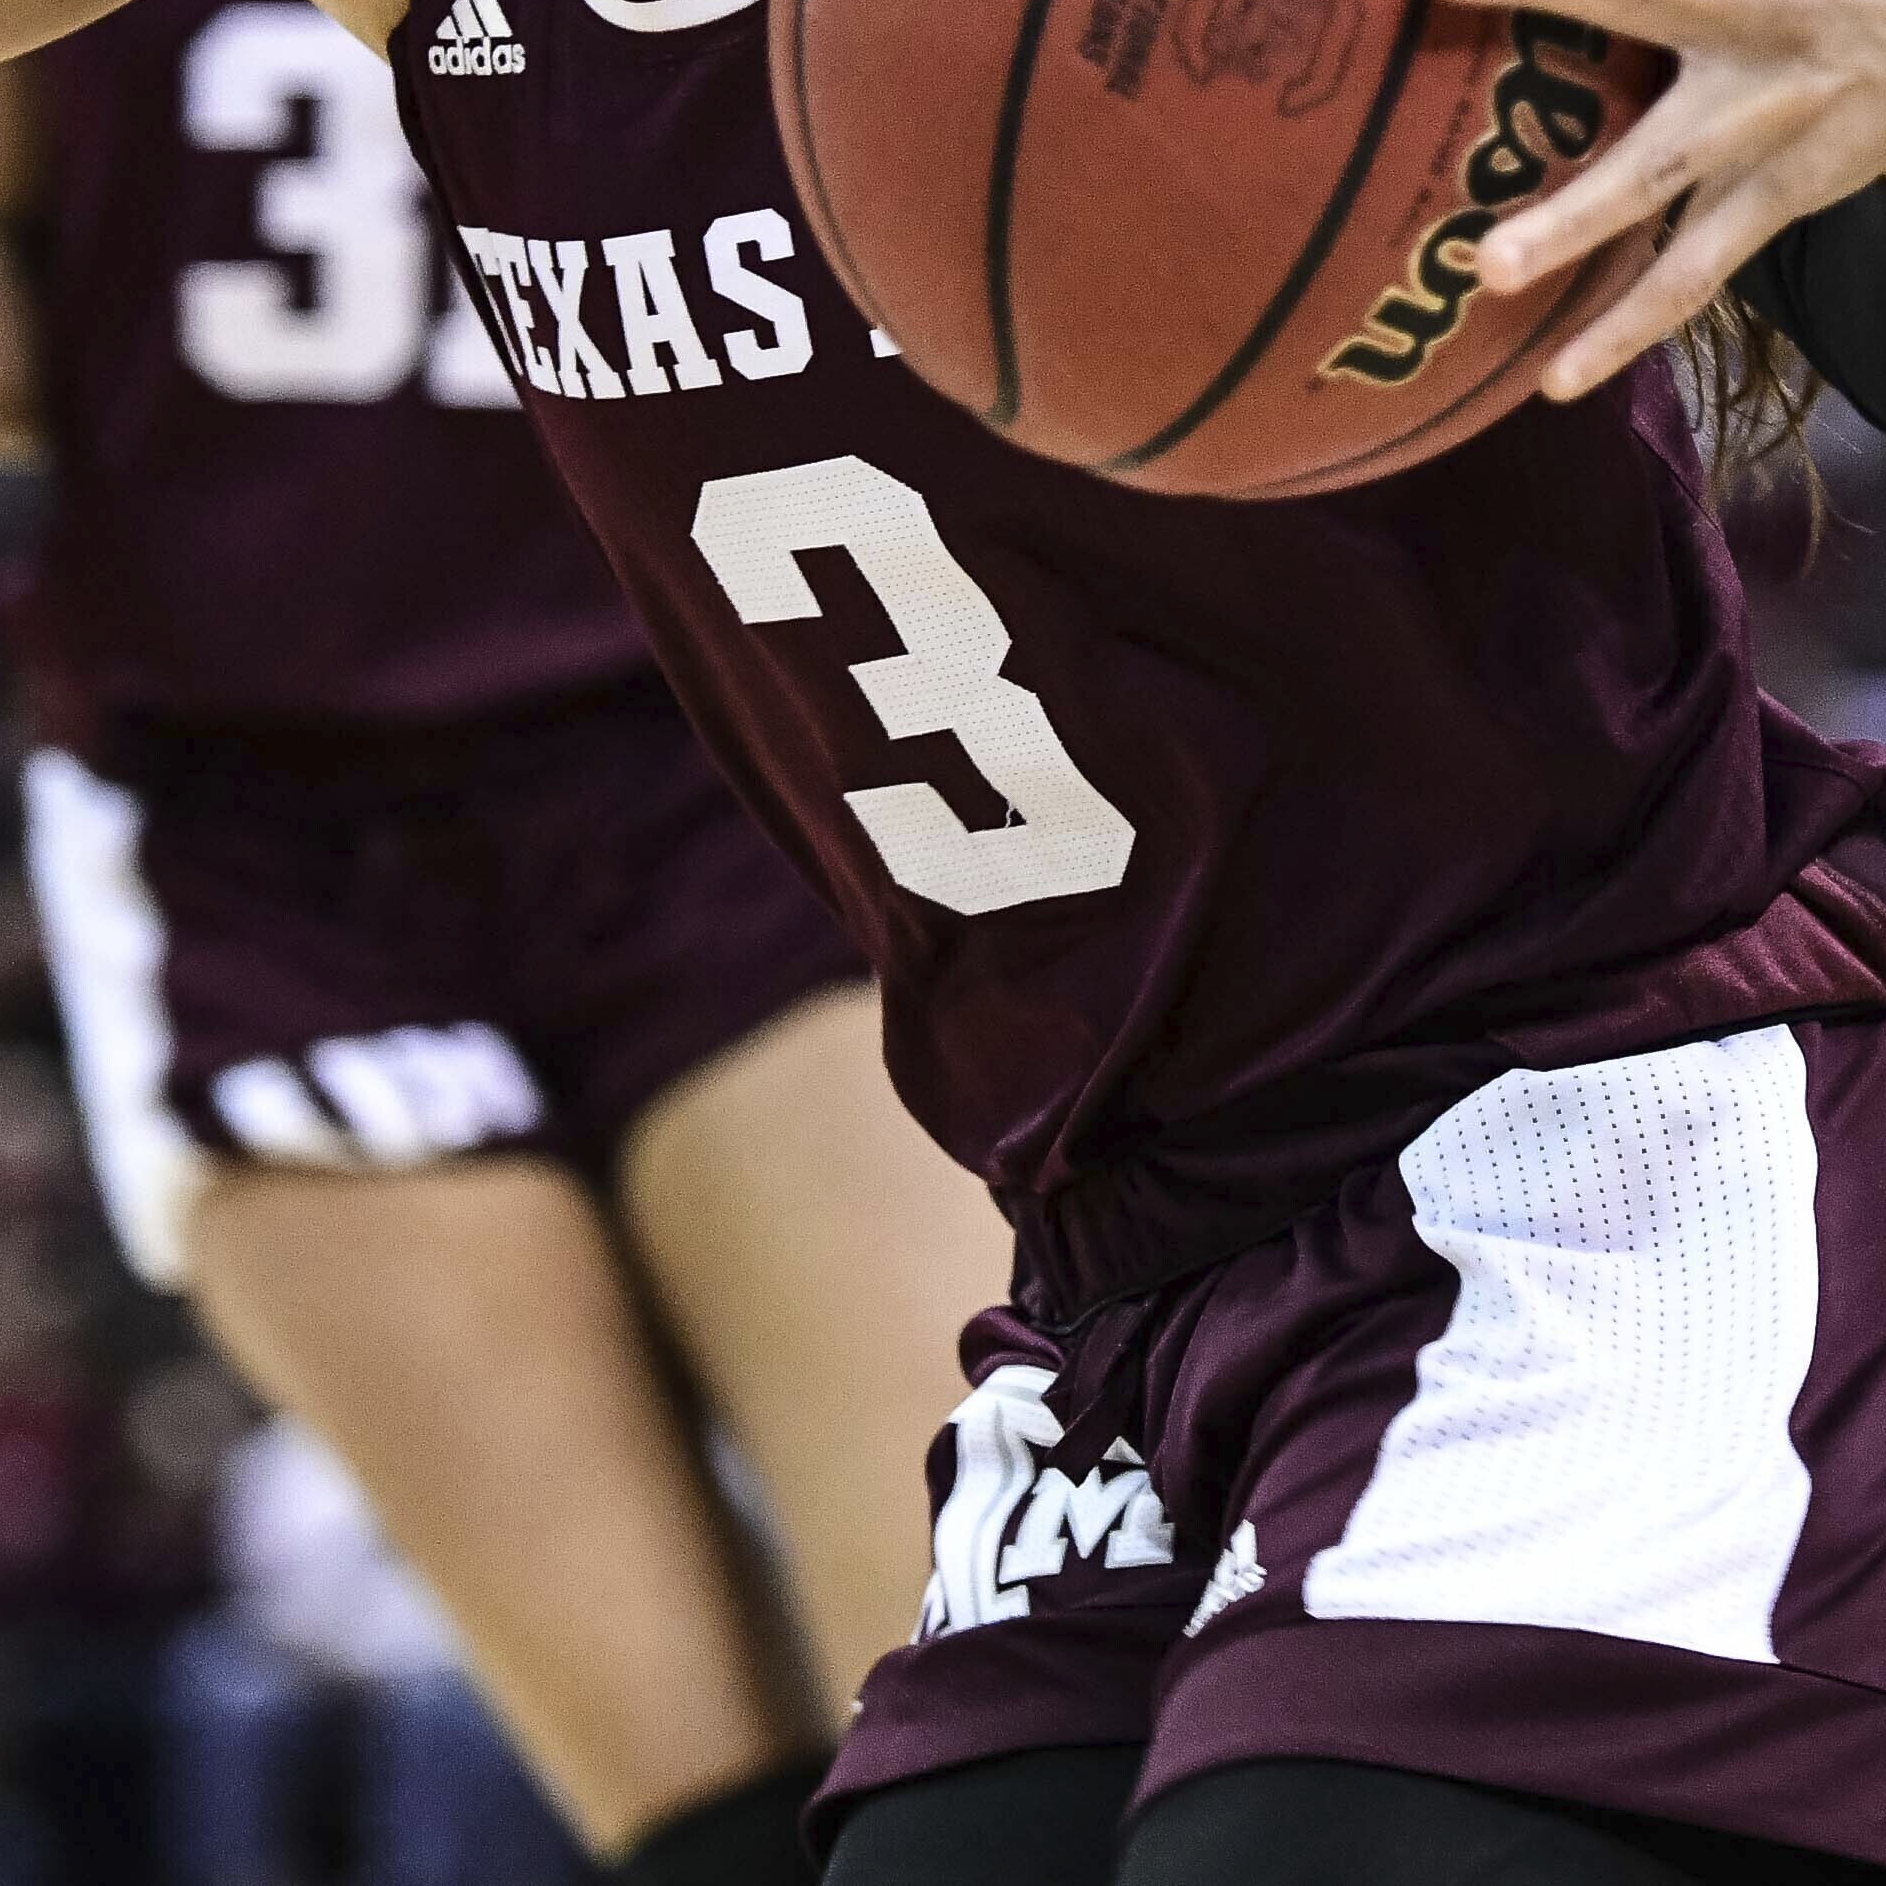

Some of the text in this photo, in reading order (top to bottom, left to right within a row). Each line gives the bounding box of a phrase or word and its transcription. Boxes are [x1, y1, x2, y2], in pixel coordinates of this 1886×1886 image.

[428, 35, 526, 75] adidas
[457, 207, 813, 400] TEXAS
[690, 454, 1137, 916] 3
